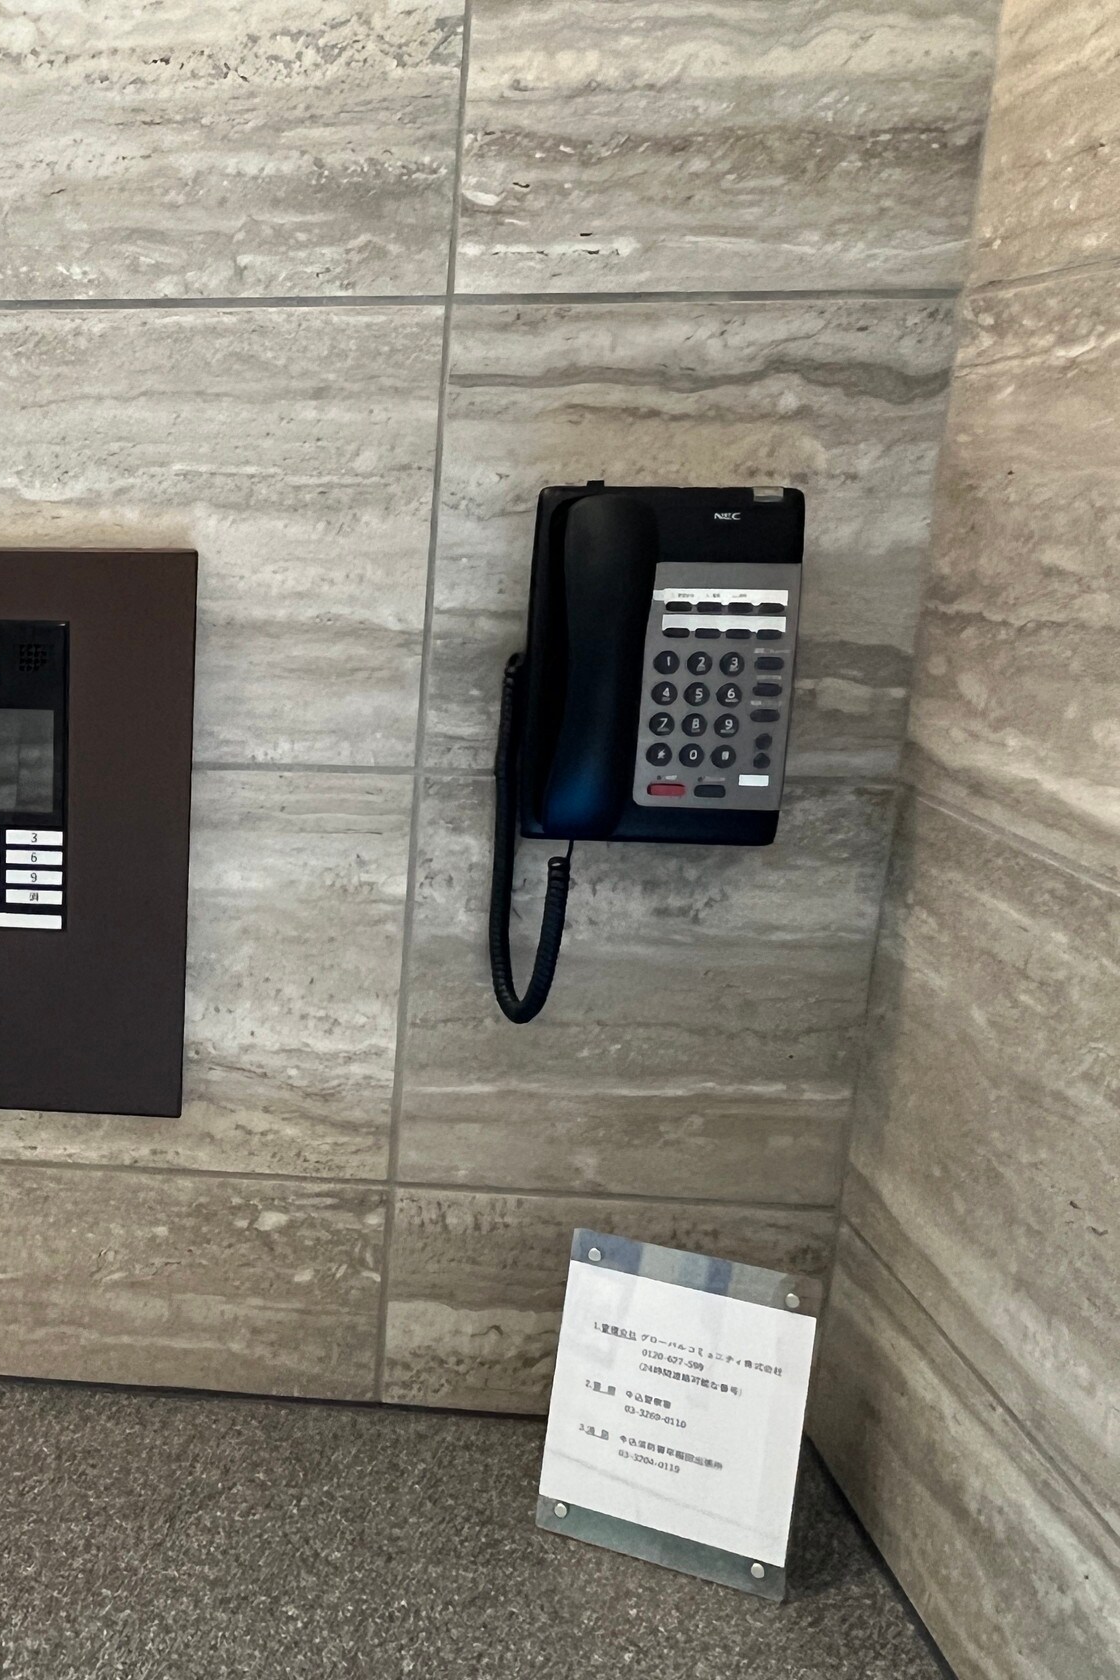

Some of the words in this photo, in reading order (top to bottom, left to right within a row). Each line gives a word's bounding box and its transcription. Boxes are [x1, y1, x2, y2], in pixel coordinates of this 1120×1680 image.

[714, 512, 741, 520] NEC
[666, 656, 671, 667] 1
[698, 656, 706, 667] 2
[730, 657, 739, 668] 3
[662, 687, 670, 698] 4
[695, 688, 703, 699] 5
[727, 688, 735, 699] 6
[659, 718, 668, 729] 7
[692, 718, 700, 729] 8
[724, 719, 733, 730] 9
[689, 750, 698, 760] 0
